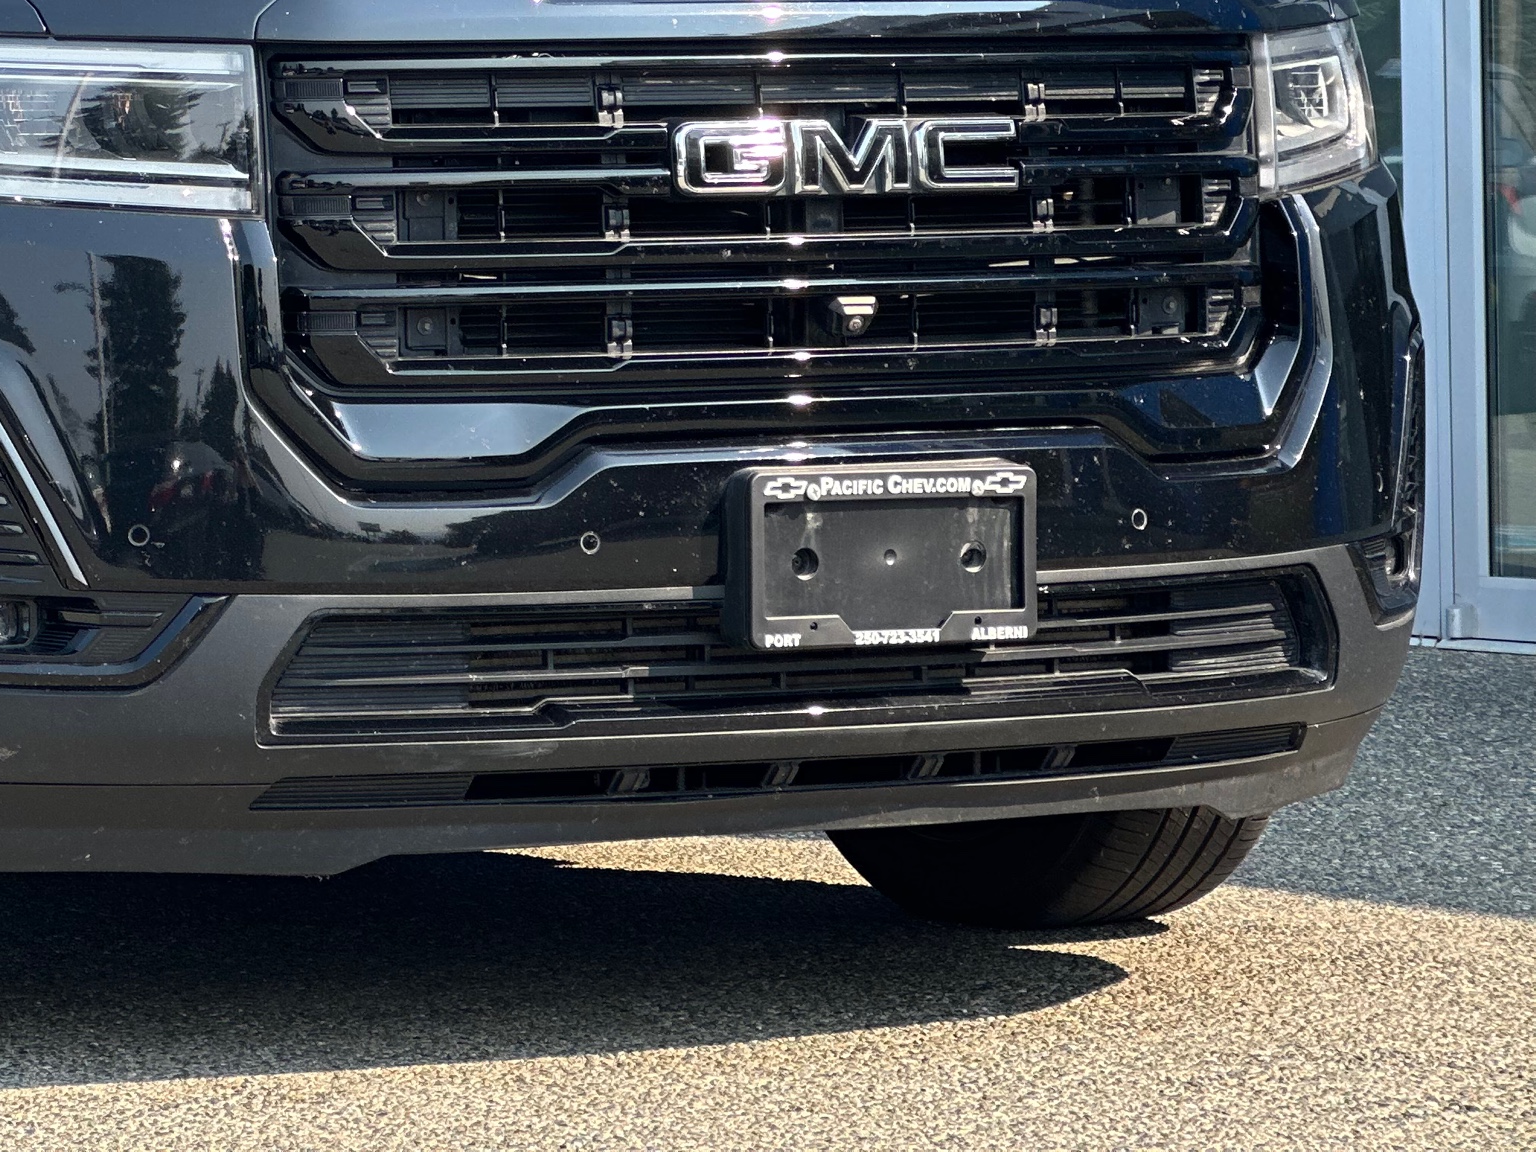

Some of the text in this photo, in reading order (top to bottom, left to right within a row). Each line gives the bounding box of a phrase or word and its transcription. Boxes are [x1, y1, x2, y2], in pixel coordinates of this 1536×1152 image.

[673, 117, 1019, 195] GMC
[819, 474, 972, 496] PACIFIC CHEV.COM
[764, 633, 802, 649] PORT
[970, 626, 1029, 641] ALBERNI
